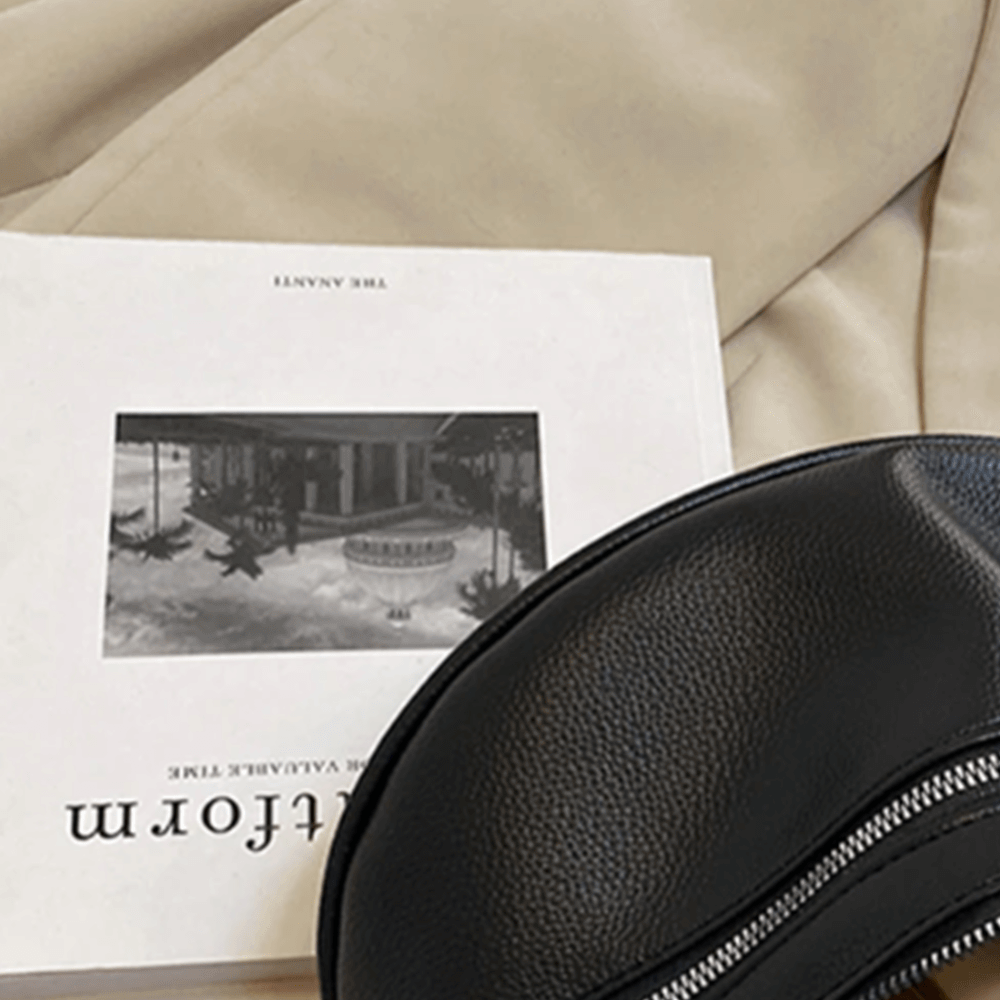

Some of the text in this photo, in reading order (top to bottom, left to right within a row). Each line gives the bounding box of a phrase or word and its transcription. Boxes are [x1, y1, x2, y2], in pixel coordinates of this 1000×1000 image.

[274, 275, 387, 289] THE ANANTI
[168, 765, 222, 780] TIME
[228, 760, 340, 777] VALUABLE
